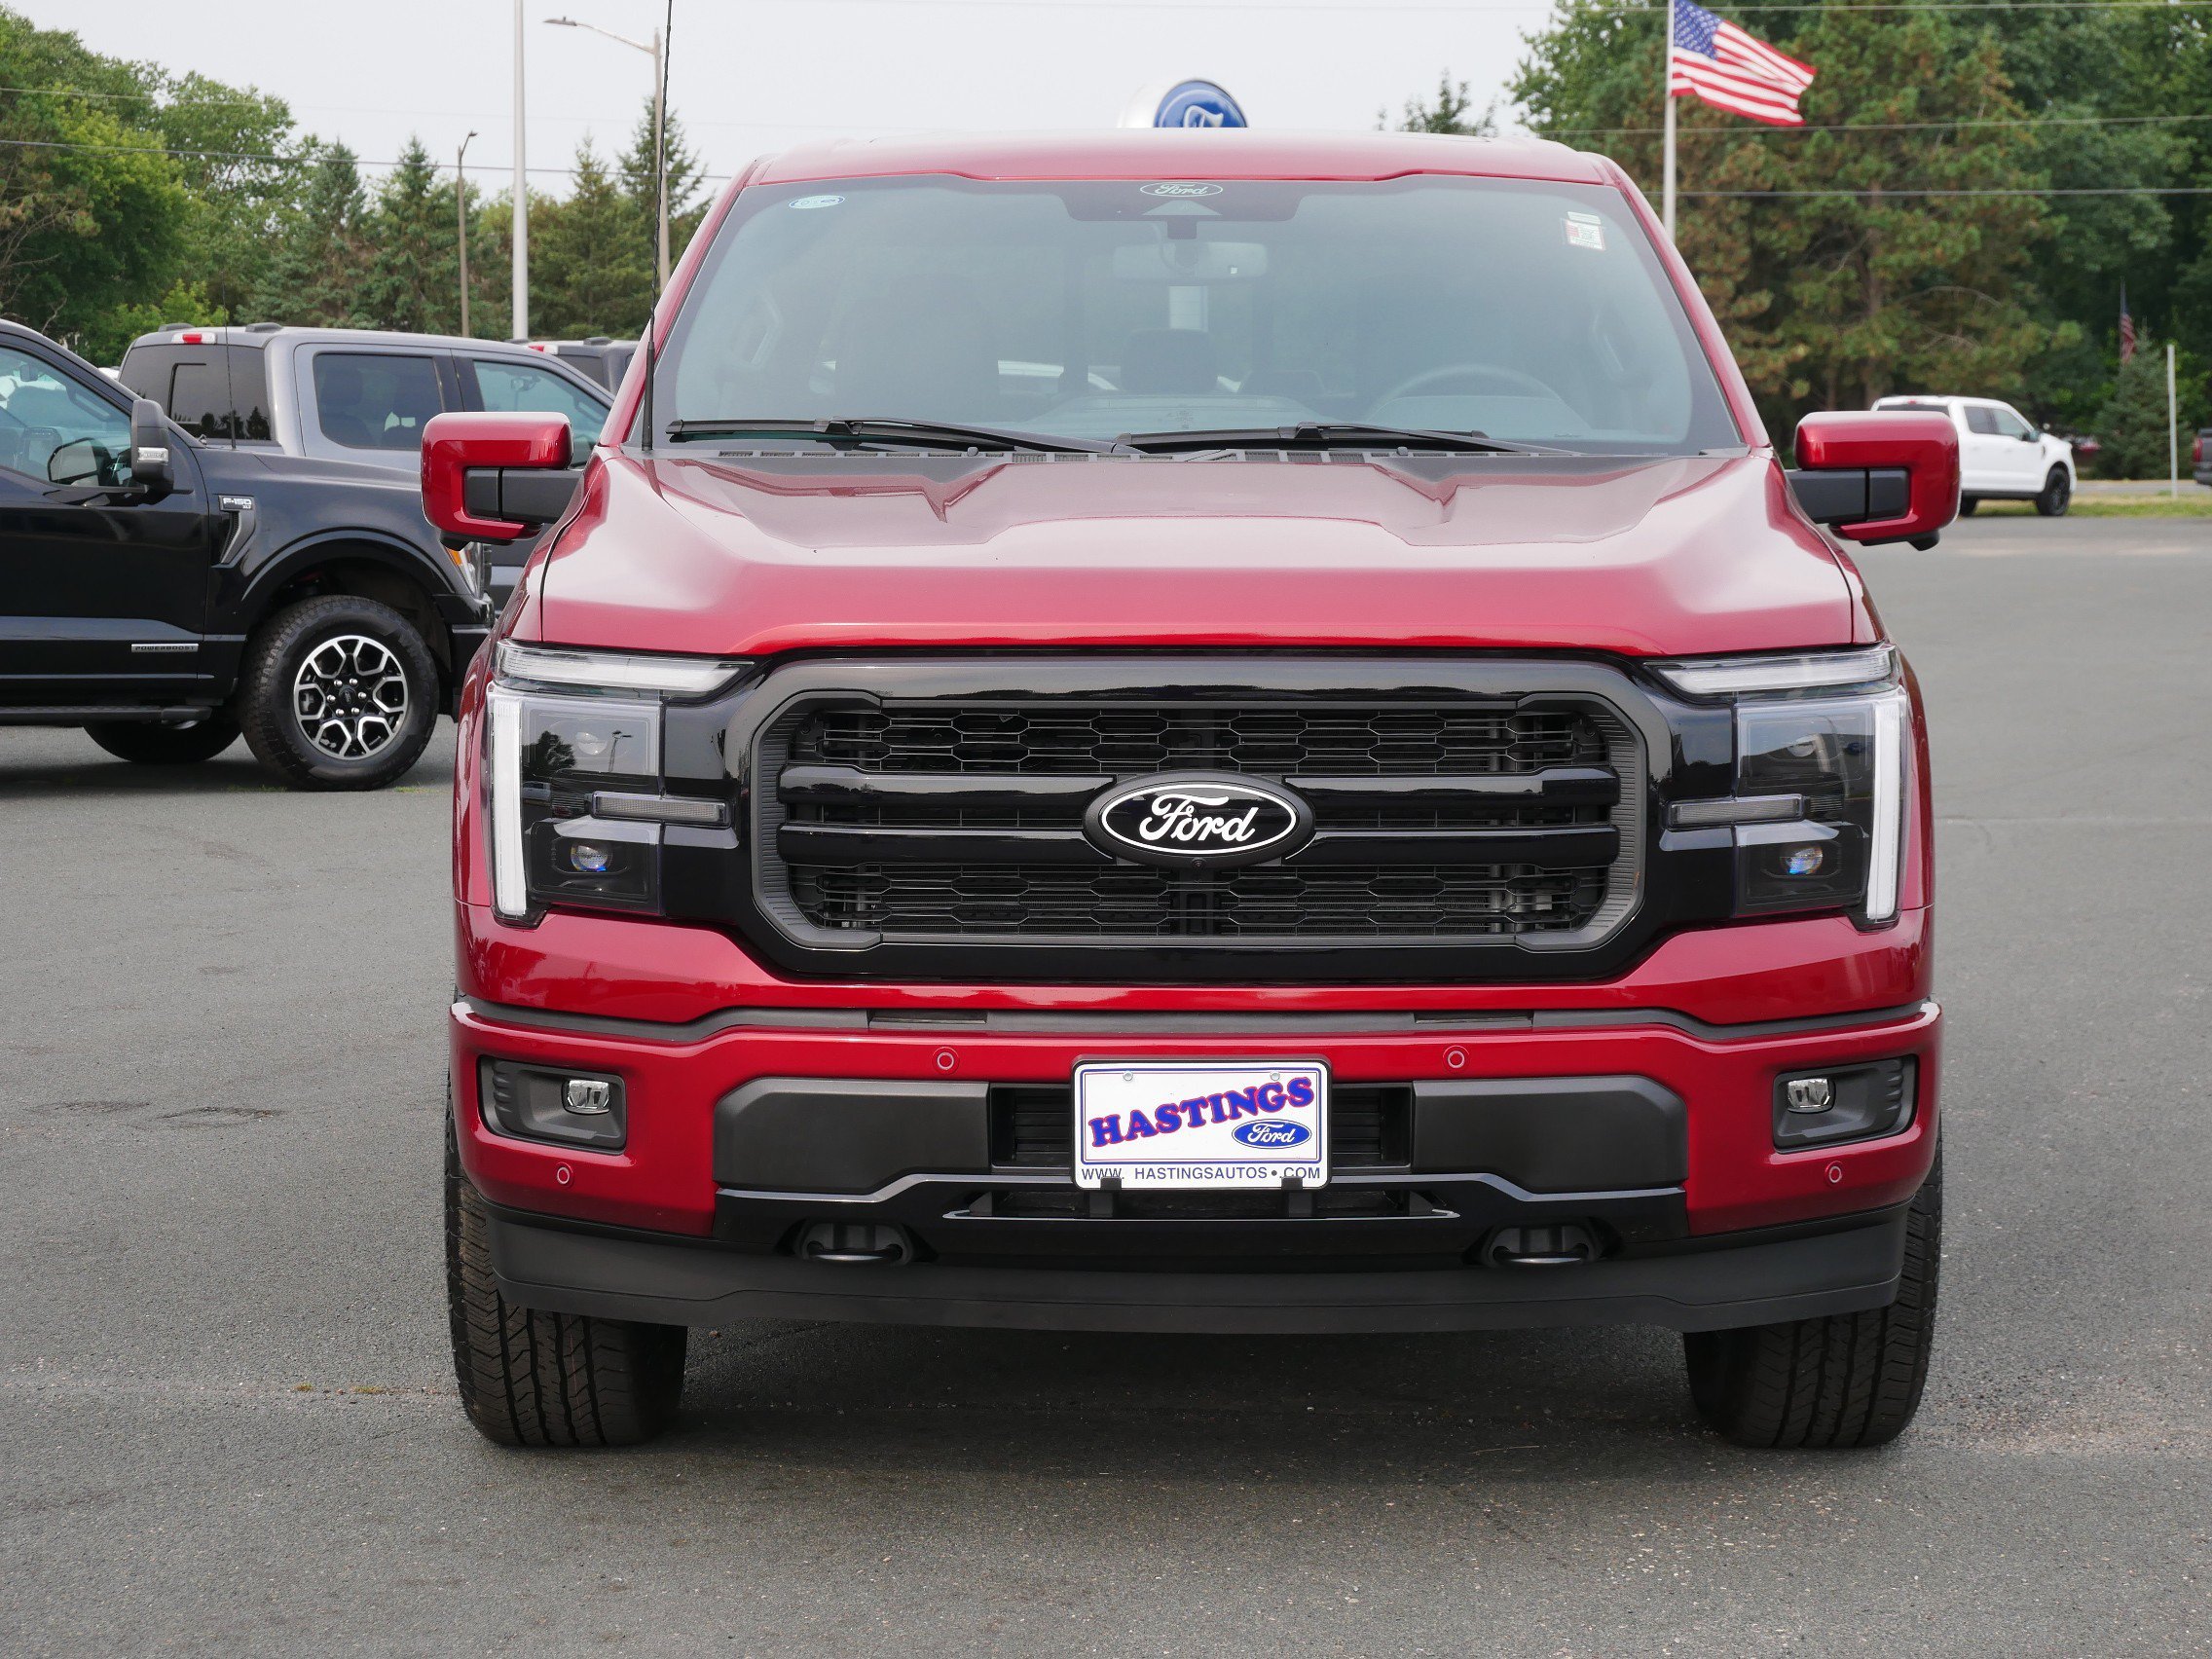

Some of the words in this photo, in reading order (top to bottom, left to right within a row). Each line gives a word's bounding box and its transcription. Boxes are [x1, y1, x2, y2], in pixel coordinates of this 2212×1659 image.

[1154, 183, 1209, 195] Ford
[1138, 793, 1260, 842] Ford
[1088, 1077, 1314, 1148] HASTINGS
[1247, 1123, 1296, 1144] Ford
[1134, 1167, 1268, 1179] HASTINGSAUTOS
